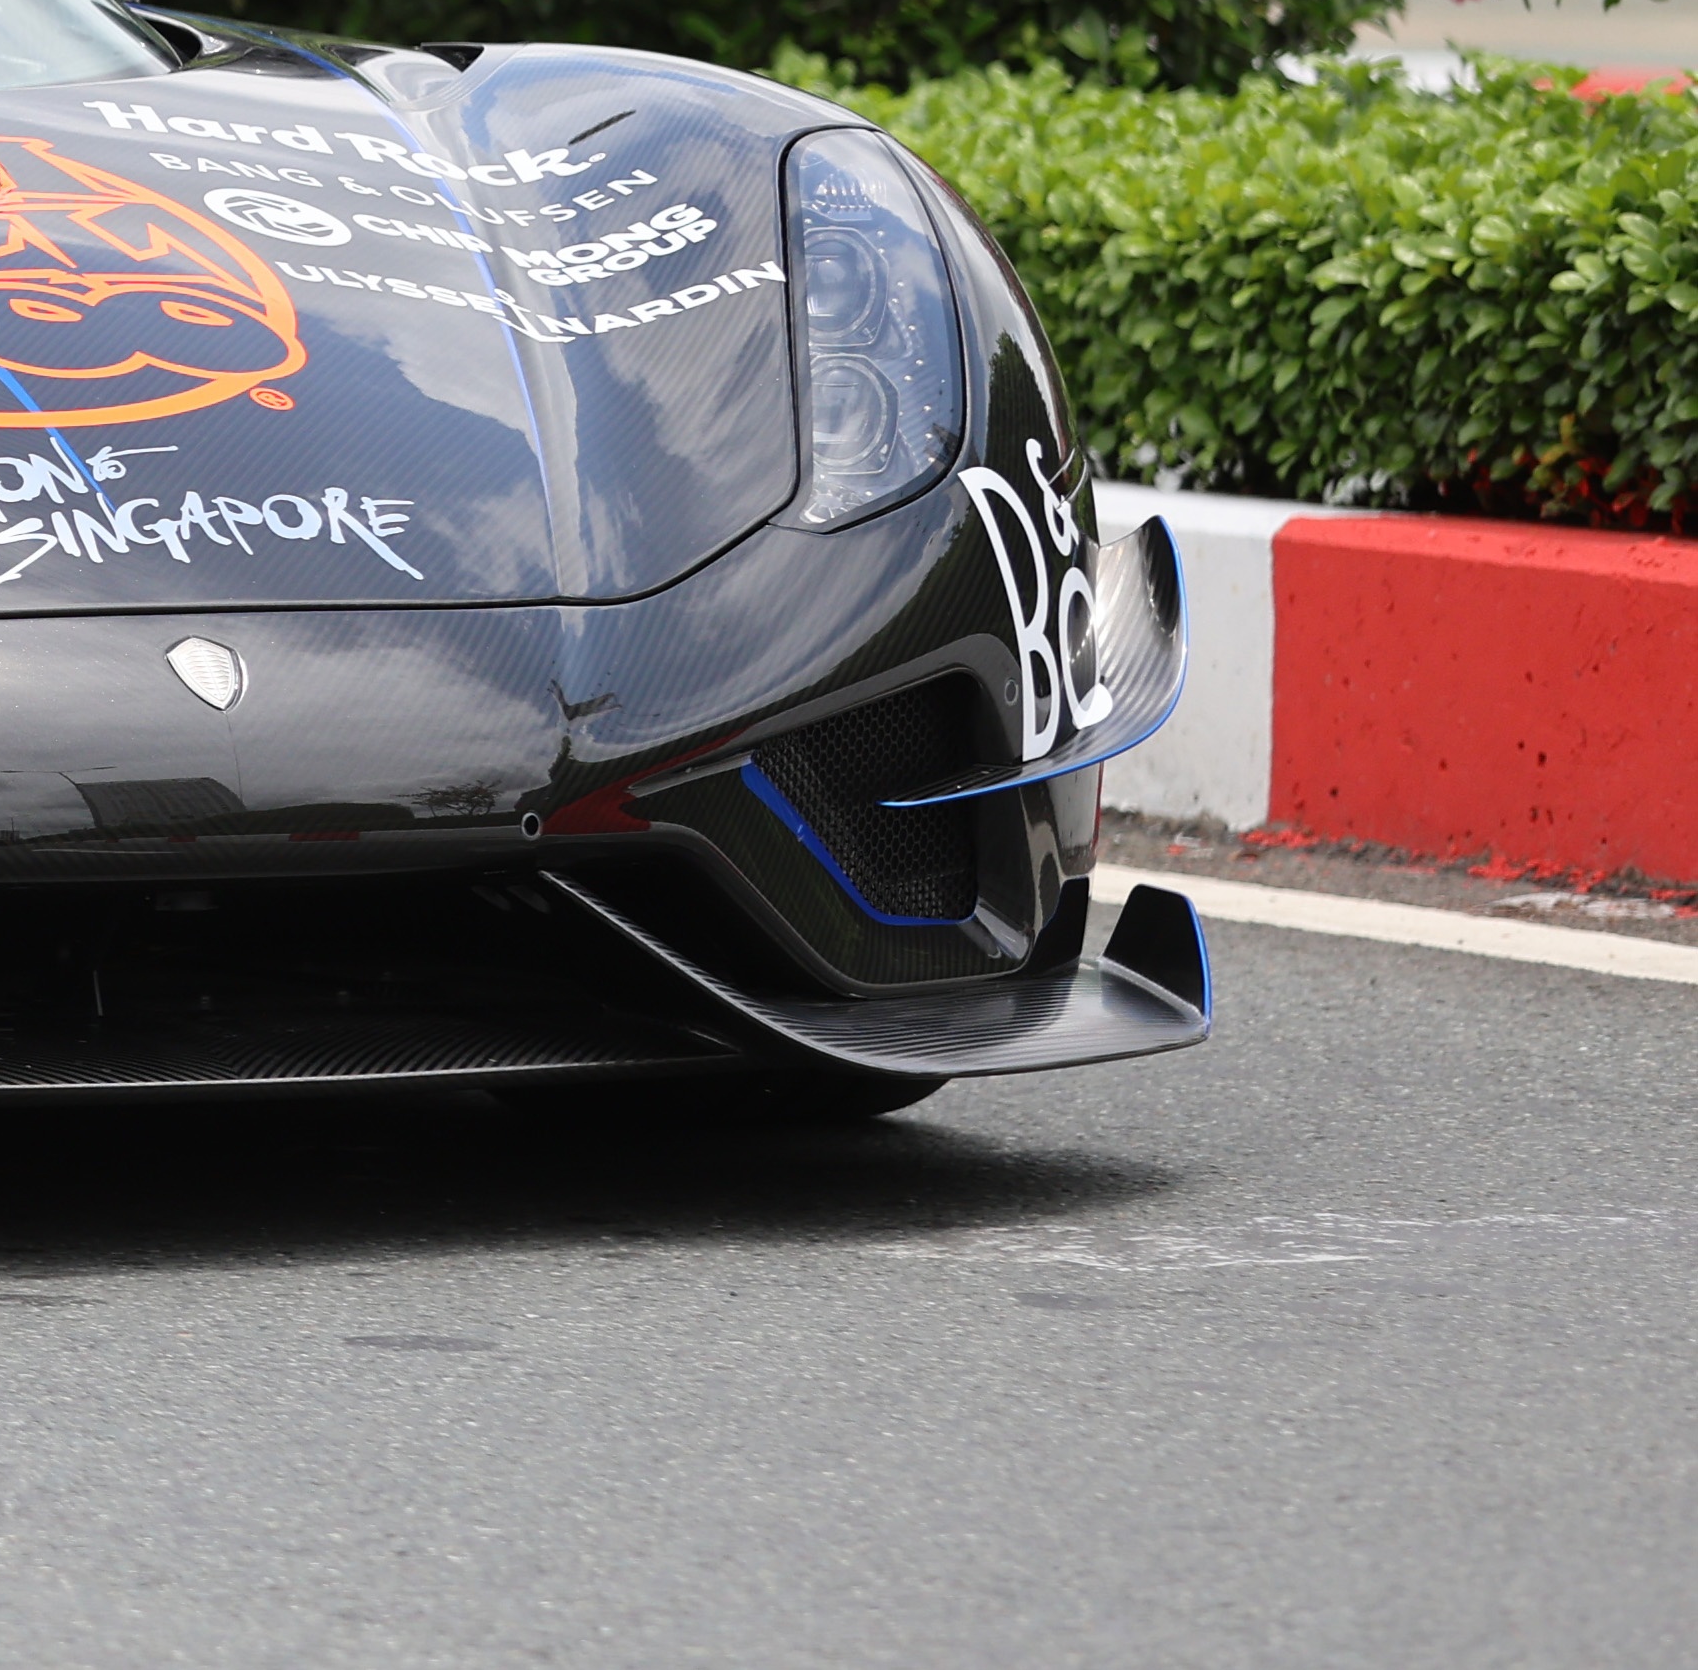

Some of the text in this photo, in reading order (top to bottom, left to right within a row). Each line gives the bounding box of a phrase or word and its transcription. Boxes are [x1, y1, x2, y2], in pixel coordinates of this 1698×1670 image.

[82, 100, 595, 188] Hard Rock
[148, 151, 659, 228] BANG & OLUFSEN
[352, 201, 704, 271] CHIP MONG
[526, 216, 718, 287] GROUP
[274, 260, 786, 335] ULYSSE NARDIN
